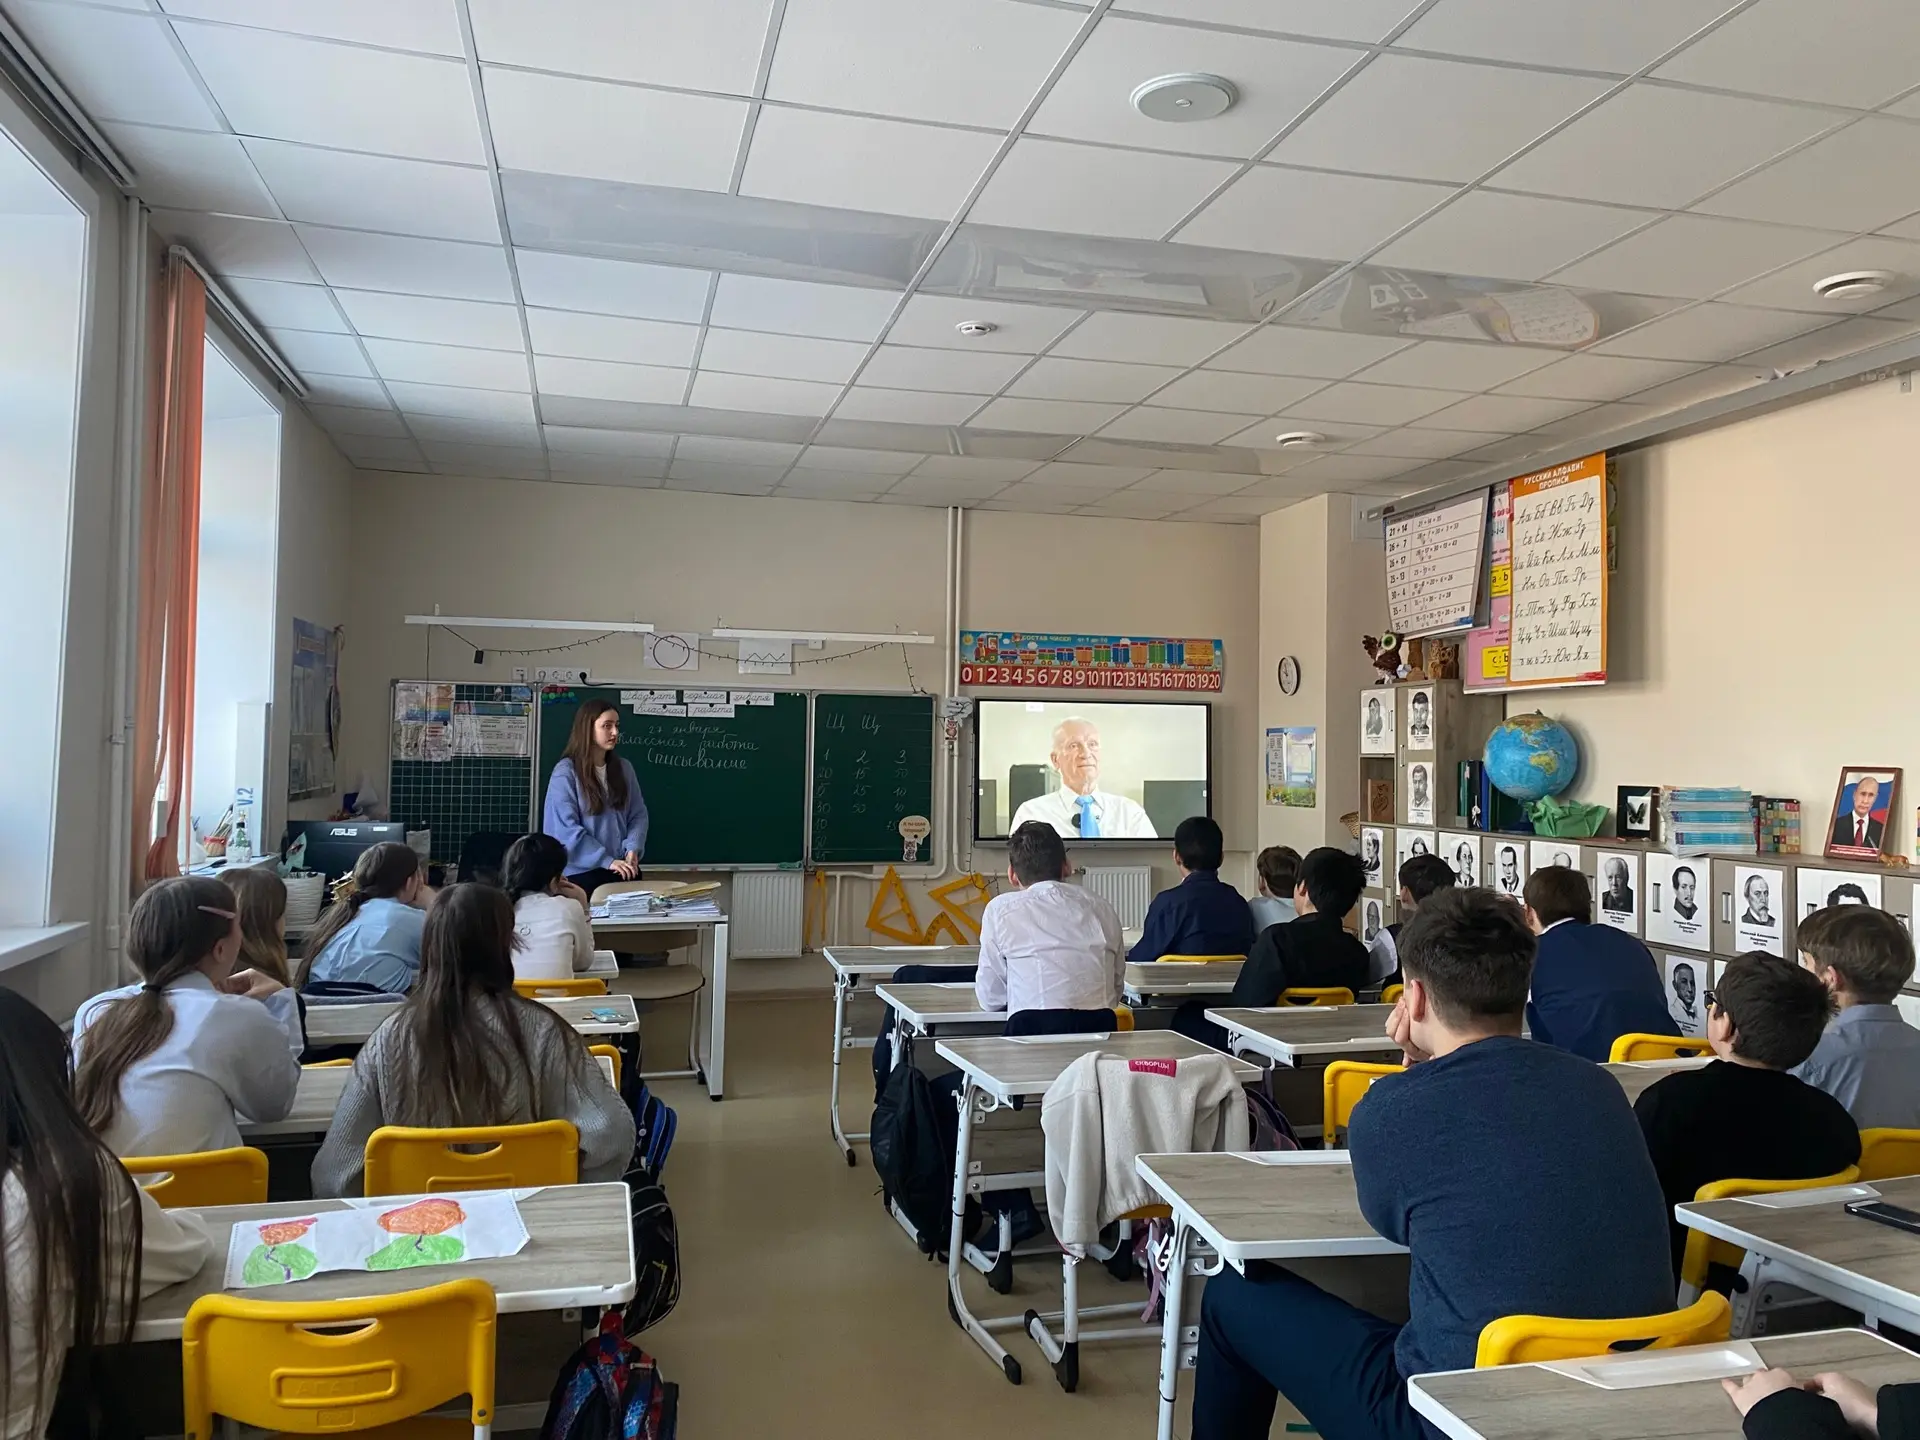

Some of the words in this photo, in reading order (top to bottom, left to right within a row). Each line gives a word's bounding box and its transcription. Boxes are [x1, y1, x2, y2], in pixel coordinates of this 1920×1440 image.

[1523, 470, 1552, 486] РУССКИЙ
[1539, 476, 1569, 490] ПРОПИСИ
[962, 667, 972, 682] 0
[976, 668, 983, 682] 1
[987, 668, 997, 683] 2
[1000, 668, 1010, 683] 3
[1012, 669, 1023, 684] 4
[1025, 669, 1035, 684] 5
[1038, 669, 1048, 684] 6
[1050, 669, 1060, 685] 7
[1063, 670, 1073, 685] 8
[1075, 670, 1085, 685] 9
[1087, 670, 1099, 686] 10
[1100, 671, 1111, 687] 11
[1112, 671, 1123, 687] 12
[1124, 672, 1136, 687] 13
[1136, 672, 1148, 687] 14
[1148, 672, 1160, 687] 15
[1160, 673, 1172, 688] 16
[1172, 673, 1185, 688] 17
[1185, 673, 1196, 688] 18
[1197, 673, 1208, 688] 19
[1209, 674, 1220, 689] 20
[617, 731, 687, 748] Классная
[699, 733, 759, 751] работа
[647, 747, 748, 769] Списывание
[856, 751, 870, 764] 2
[330, 828, 358, 836] ASUS
